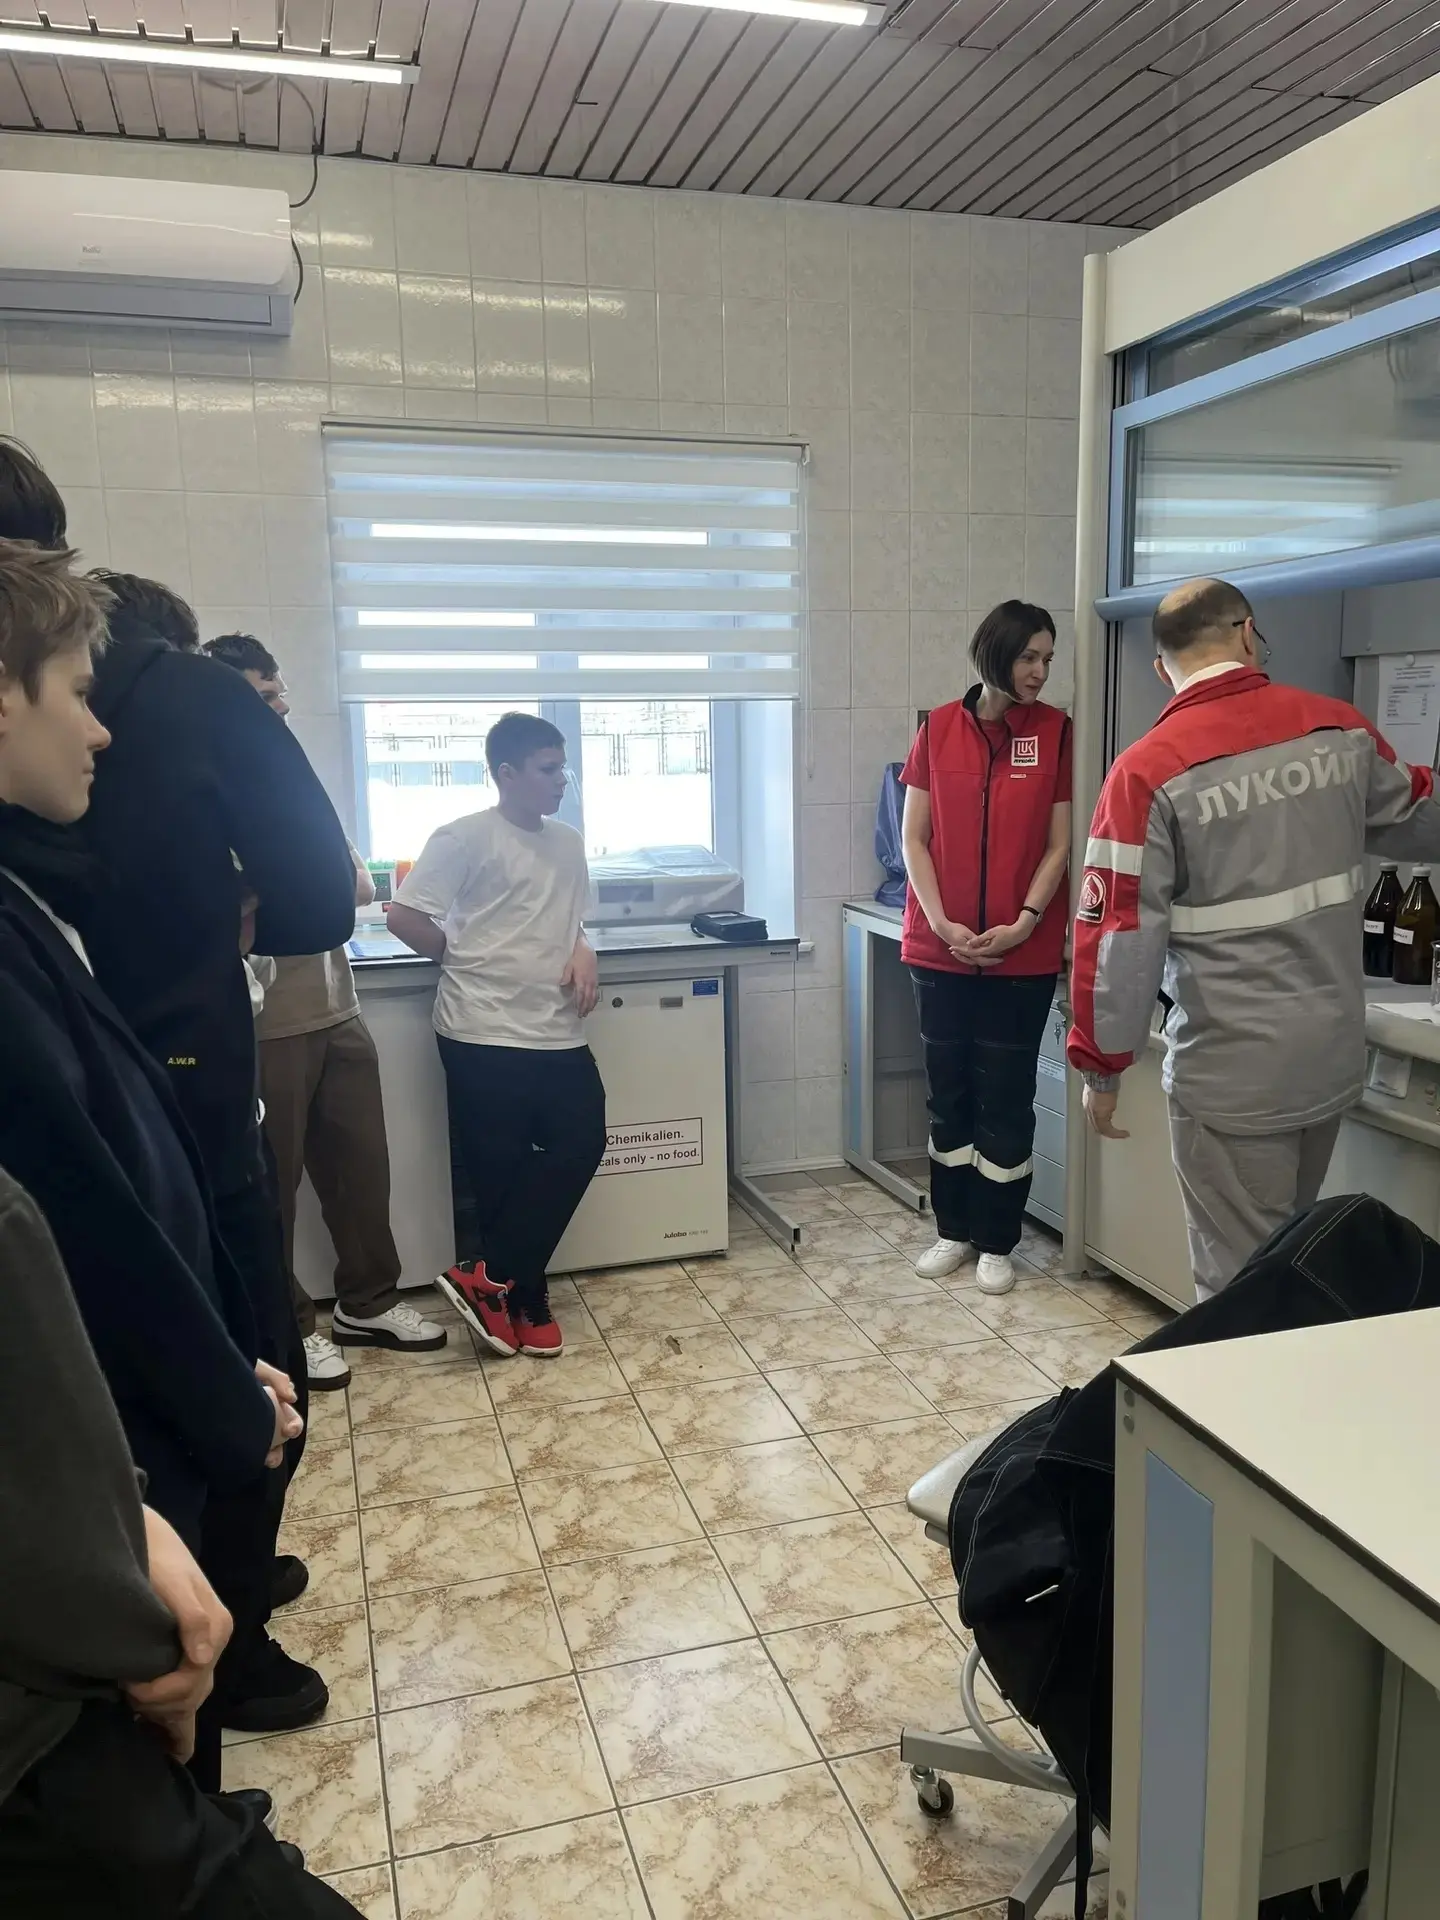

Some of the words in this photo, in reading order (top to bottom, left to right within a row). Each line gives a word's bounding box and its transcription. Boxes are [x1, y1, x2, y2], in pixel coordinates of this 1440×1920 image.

[606, 1130, 684, 1146] Chemikalien.
[623, 1152, 647, 1165] only
[657, 1152, 670, 1160] no
[673, 1148, 700, 1160] food.
